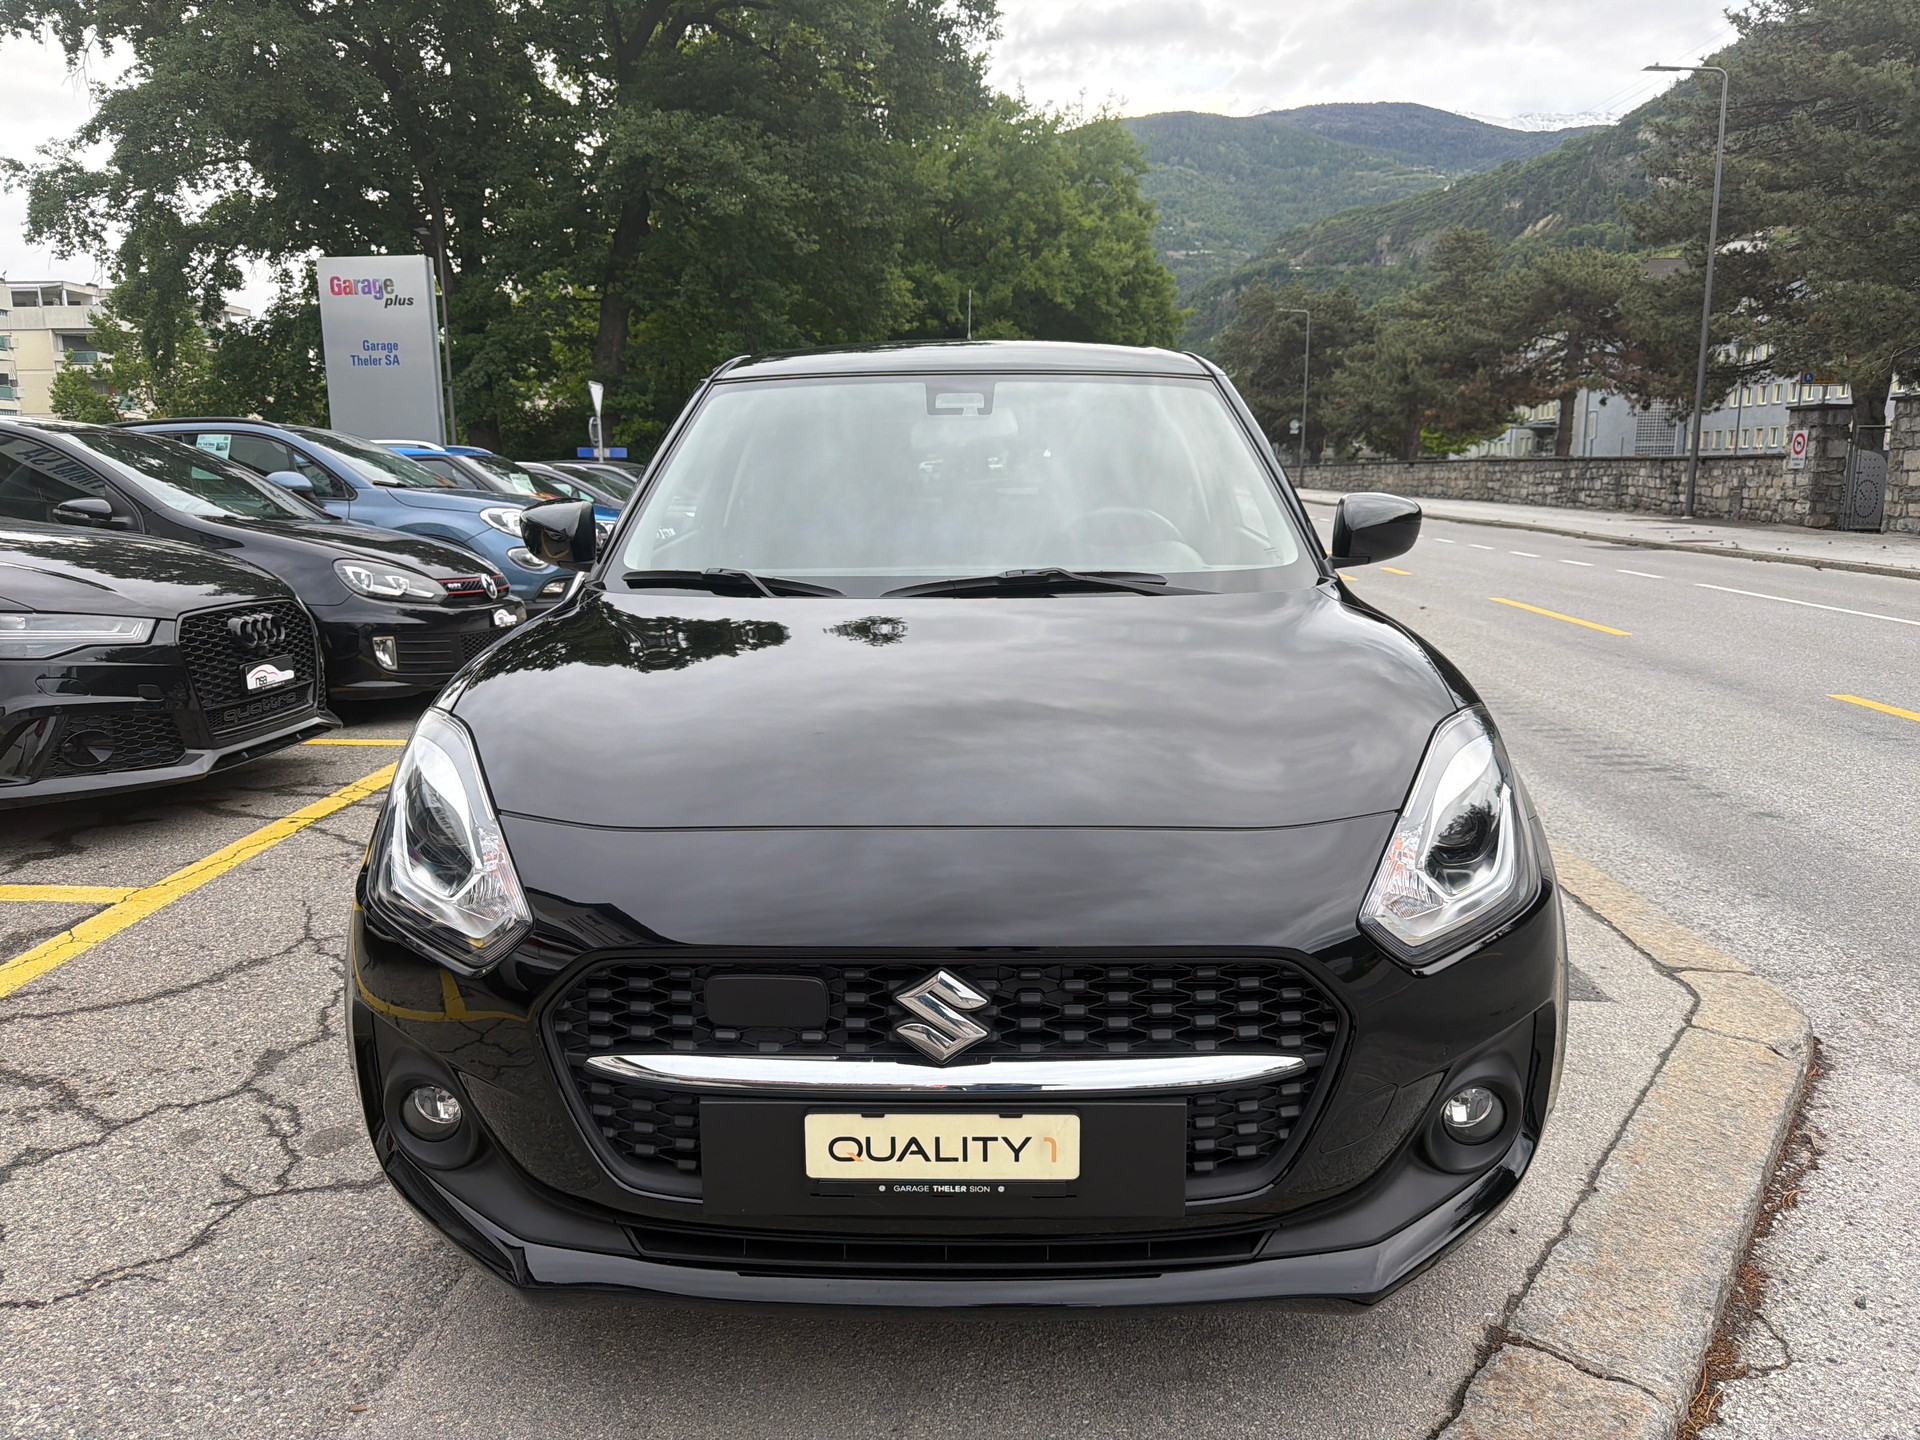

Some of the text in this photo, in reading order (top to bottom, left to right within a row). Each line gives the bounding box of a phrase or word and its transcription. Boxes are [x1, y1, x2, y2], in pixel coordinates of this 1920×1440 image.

[329, 275, 395, 300] Garage
[384, 295, 414, 309] plus
[362, 340, 399, 353] Garage
[350, 354, 400, 366] Theler SA
[224, 692, 297, 723] quattro
[828, 1136, 1057, 1163] QUALITY 1
[893, 1184, 990, 1193] GARAGE THELER SION
